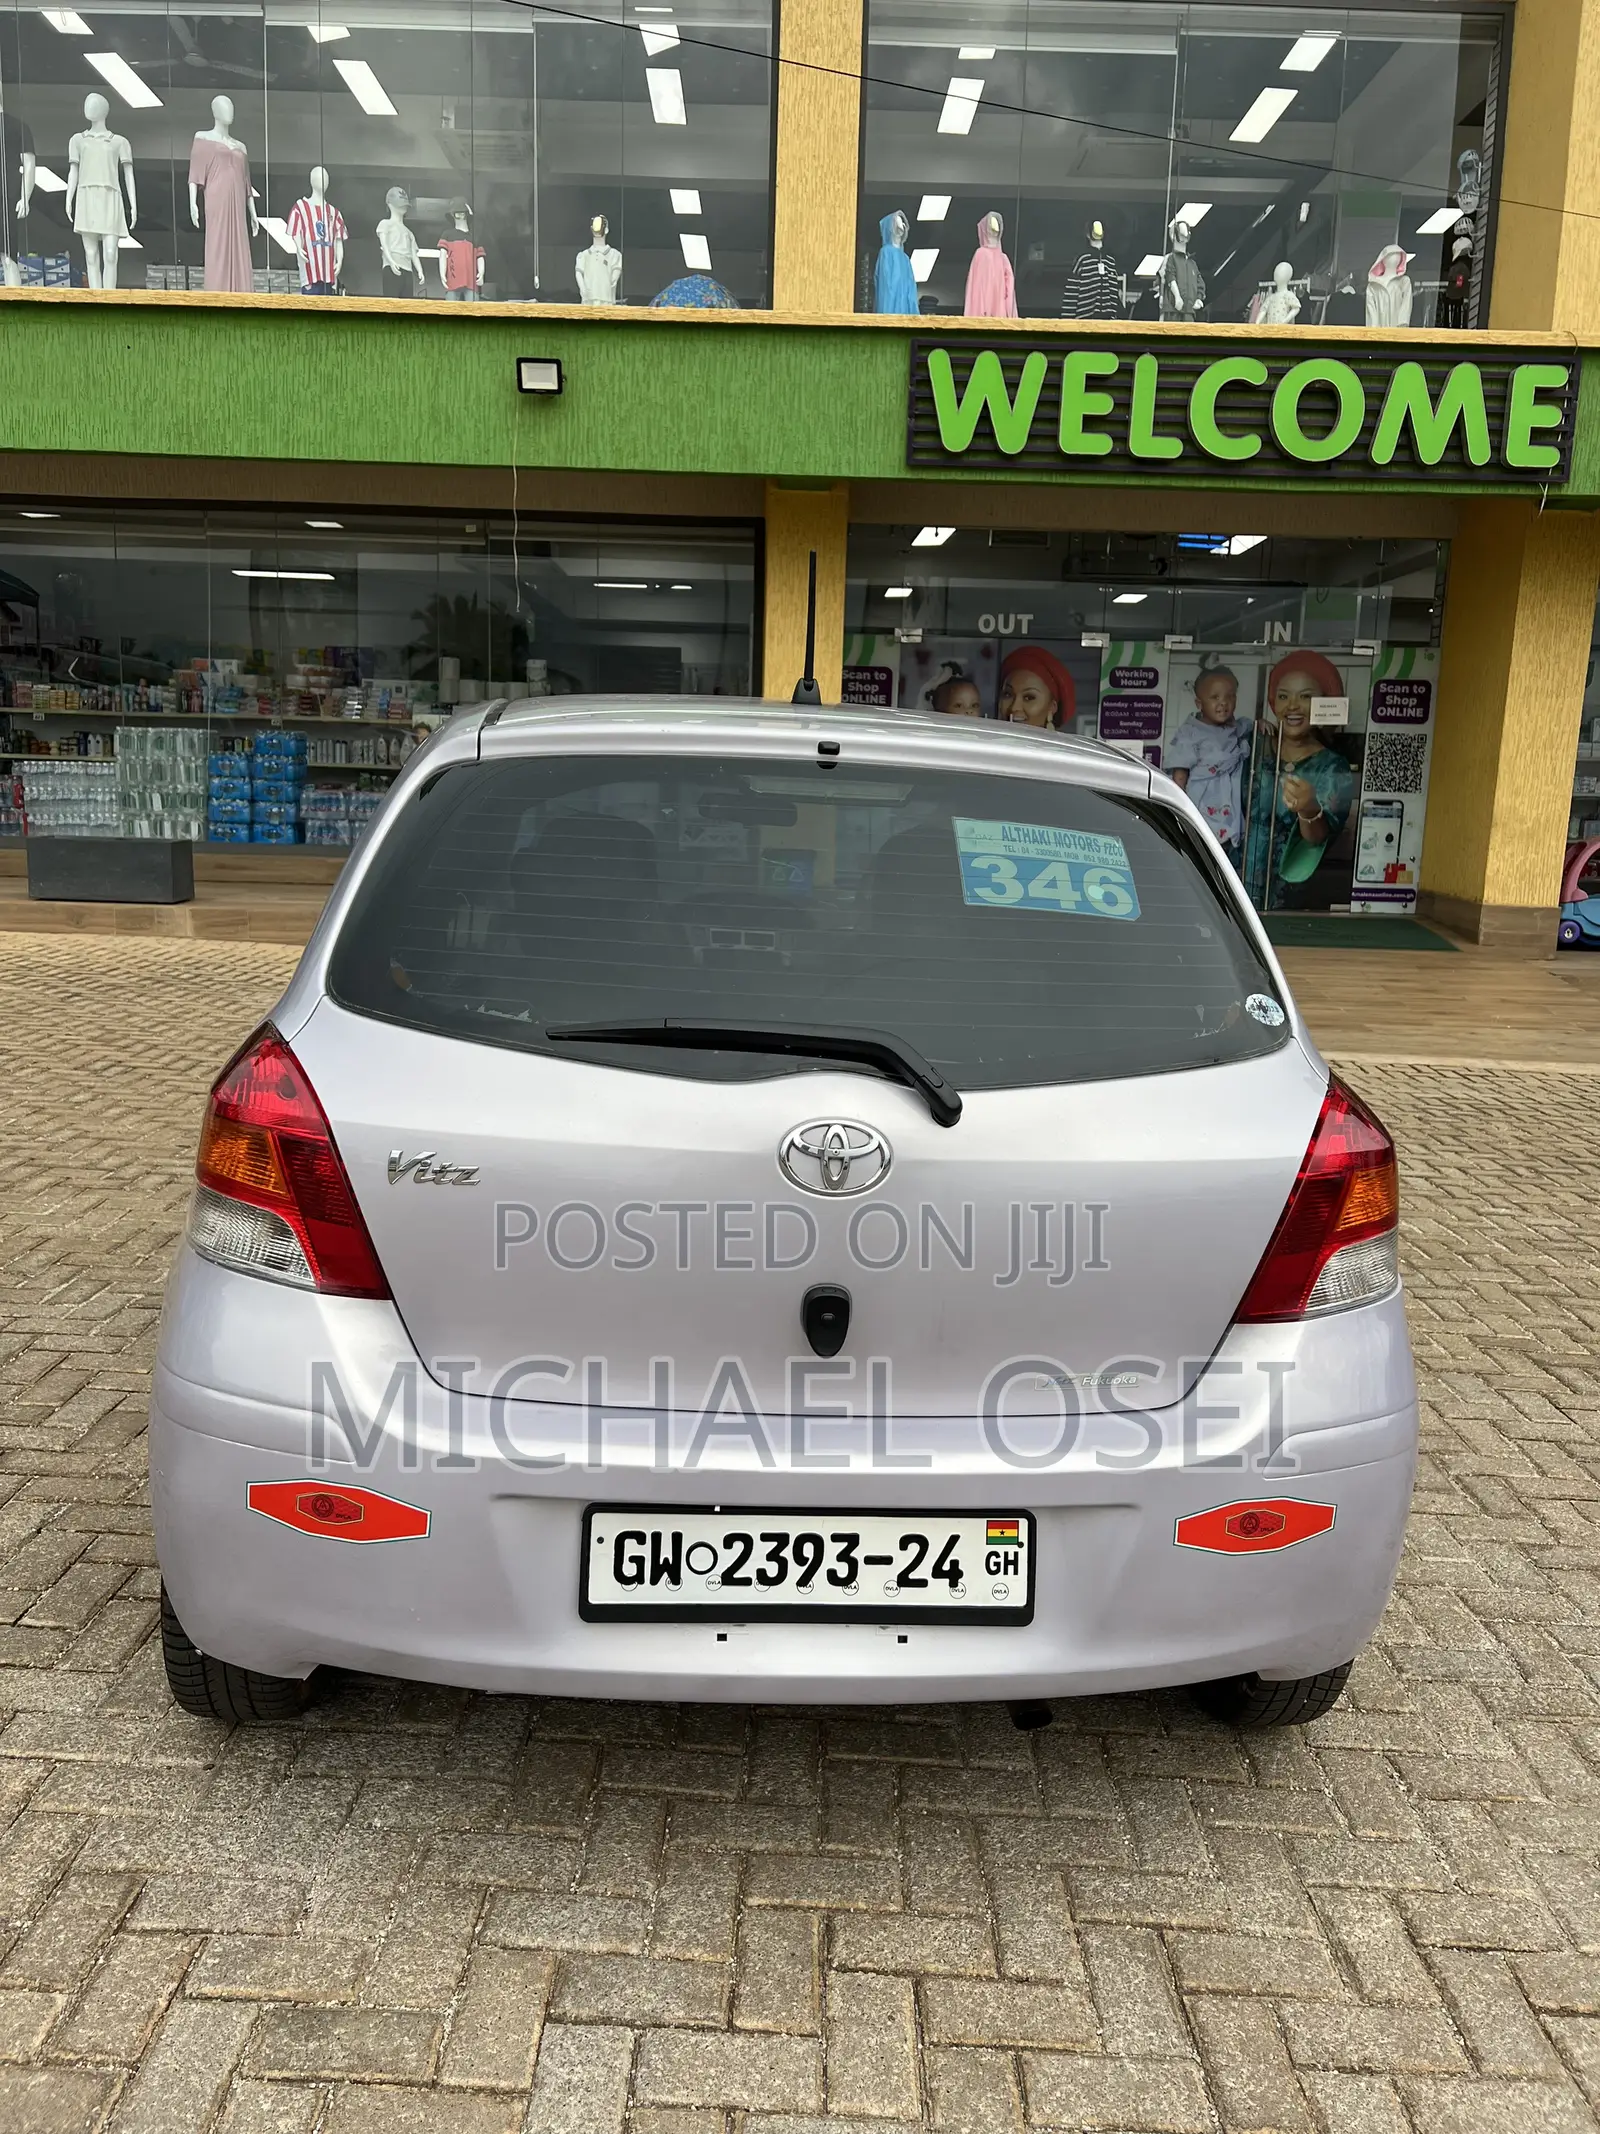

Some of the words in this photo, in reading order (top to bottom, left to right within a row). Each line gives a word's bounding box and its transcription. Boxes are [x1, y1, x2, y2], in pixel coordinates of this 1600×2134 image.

[926, 347, 1569, 469] WELCOME
[978, 613, 1034, 634] OUT
[1264, 620, 1292, 642] IN
[874, 671, 887, 680] to
[1115, 669, 1155, 679] Working
[848, 682, 879, 694] Shop
[1380, 683, 1409, 693] Scan
[1413, 684, 1426, 694] to
[1385, 695, 1417, 707] Shop
[1376, 706, 1424, 717] ONLINE
[1001, 825, 1050, 846] ALTHAKI
[1053, 831, 1101, 853] MOTORS
[1003, 845, 1016, 853] TEL
[970, 855, 1133, 916] 346
[387, 1149, 481, 1186] Vitz
[1081, 1375, 1137, 1387] Fukuoka
[613, 1530, 683, 1587] GW
[720, 1531, 964, 1588] 2393-24
[984, 1550, 1020, 1576] GH
